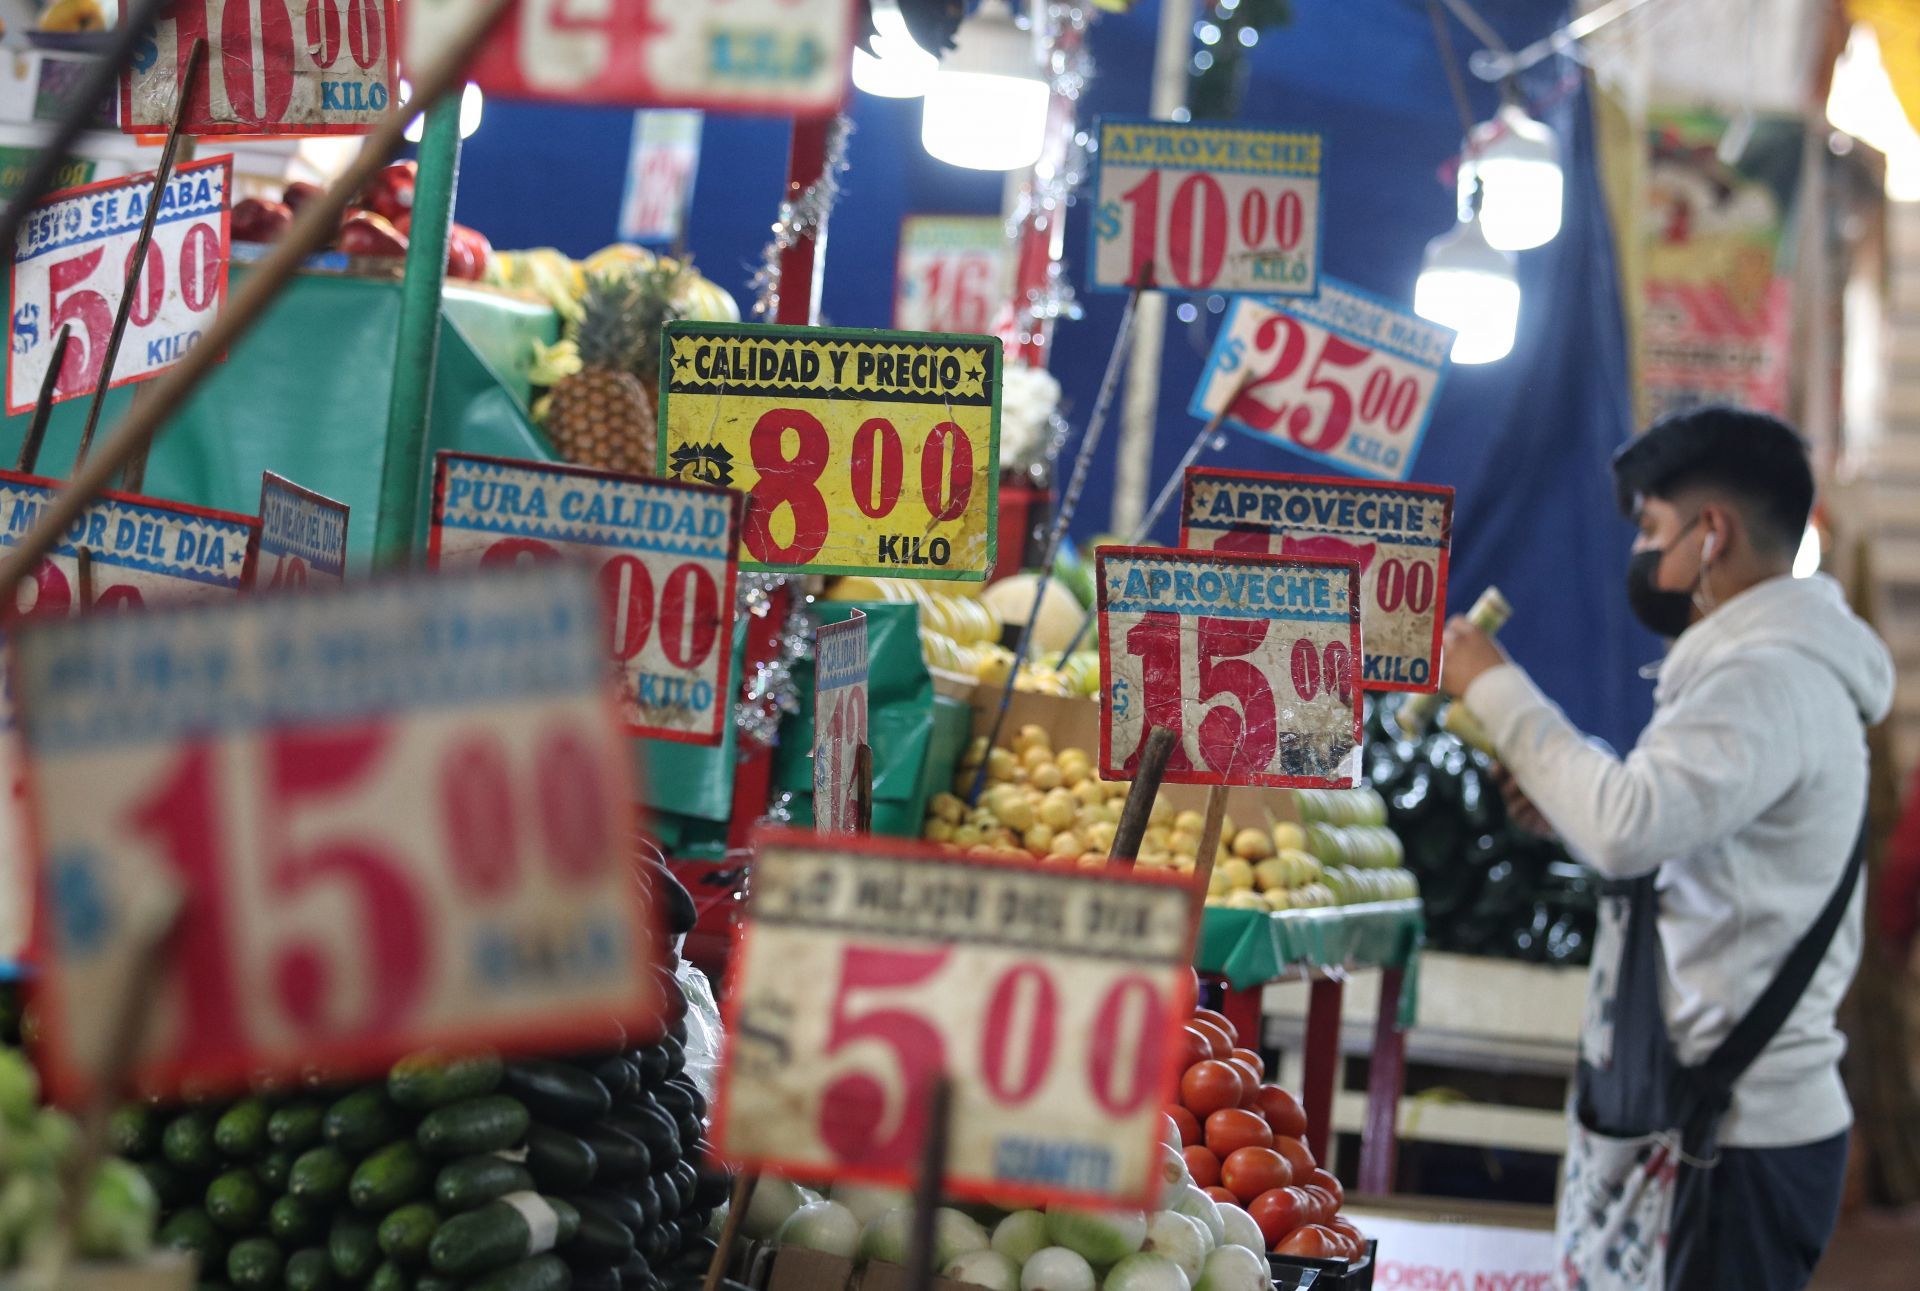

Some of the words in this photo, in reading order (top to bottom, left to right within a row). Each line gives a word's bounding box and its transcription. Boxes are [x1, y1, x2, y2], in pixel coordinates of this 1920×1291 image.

[321, 81, 387, 111] KILO
[1109, 132, 1313, 164] APROVECHE
[91, 198, 119, 228] SE
[694, 346, 820, 382] CALIDAD
[829, 351, 848, 384] Y
[858, 352, 961, 389] PRECIO
[447, 477, 548, 518] PURA
[560, 490, 727, 539] CALIDAD
[1211, 491, 1424, 532] APROVECHE
[114, 519, 166, 558] DEL
[176, 530, 226, 570] DIA
[879, 535, 950, 565] KILO
[1124, 569, 1331, 607] APROVECHE
[1363, 652, 1429, 684] KILO
[639, 672, 714, 712] KILO
